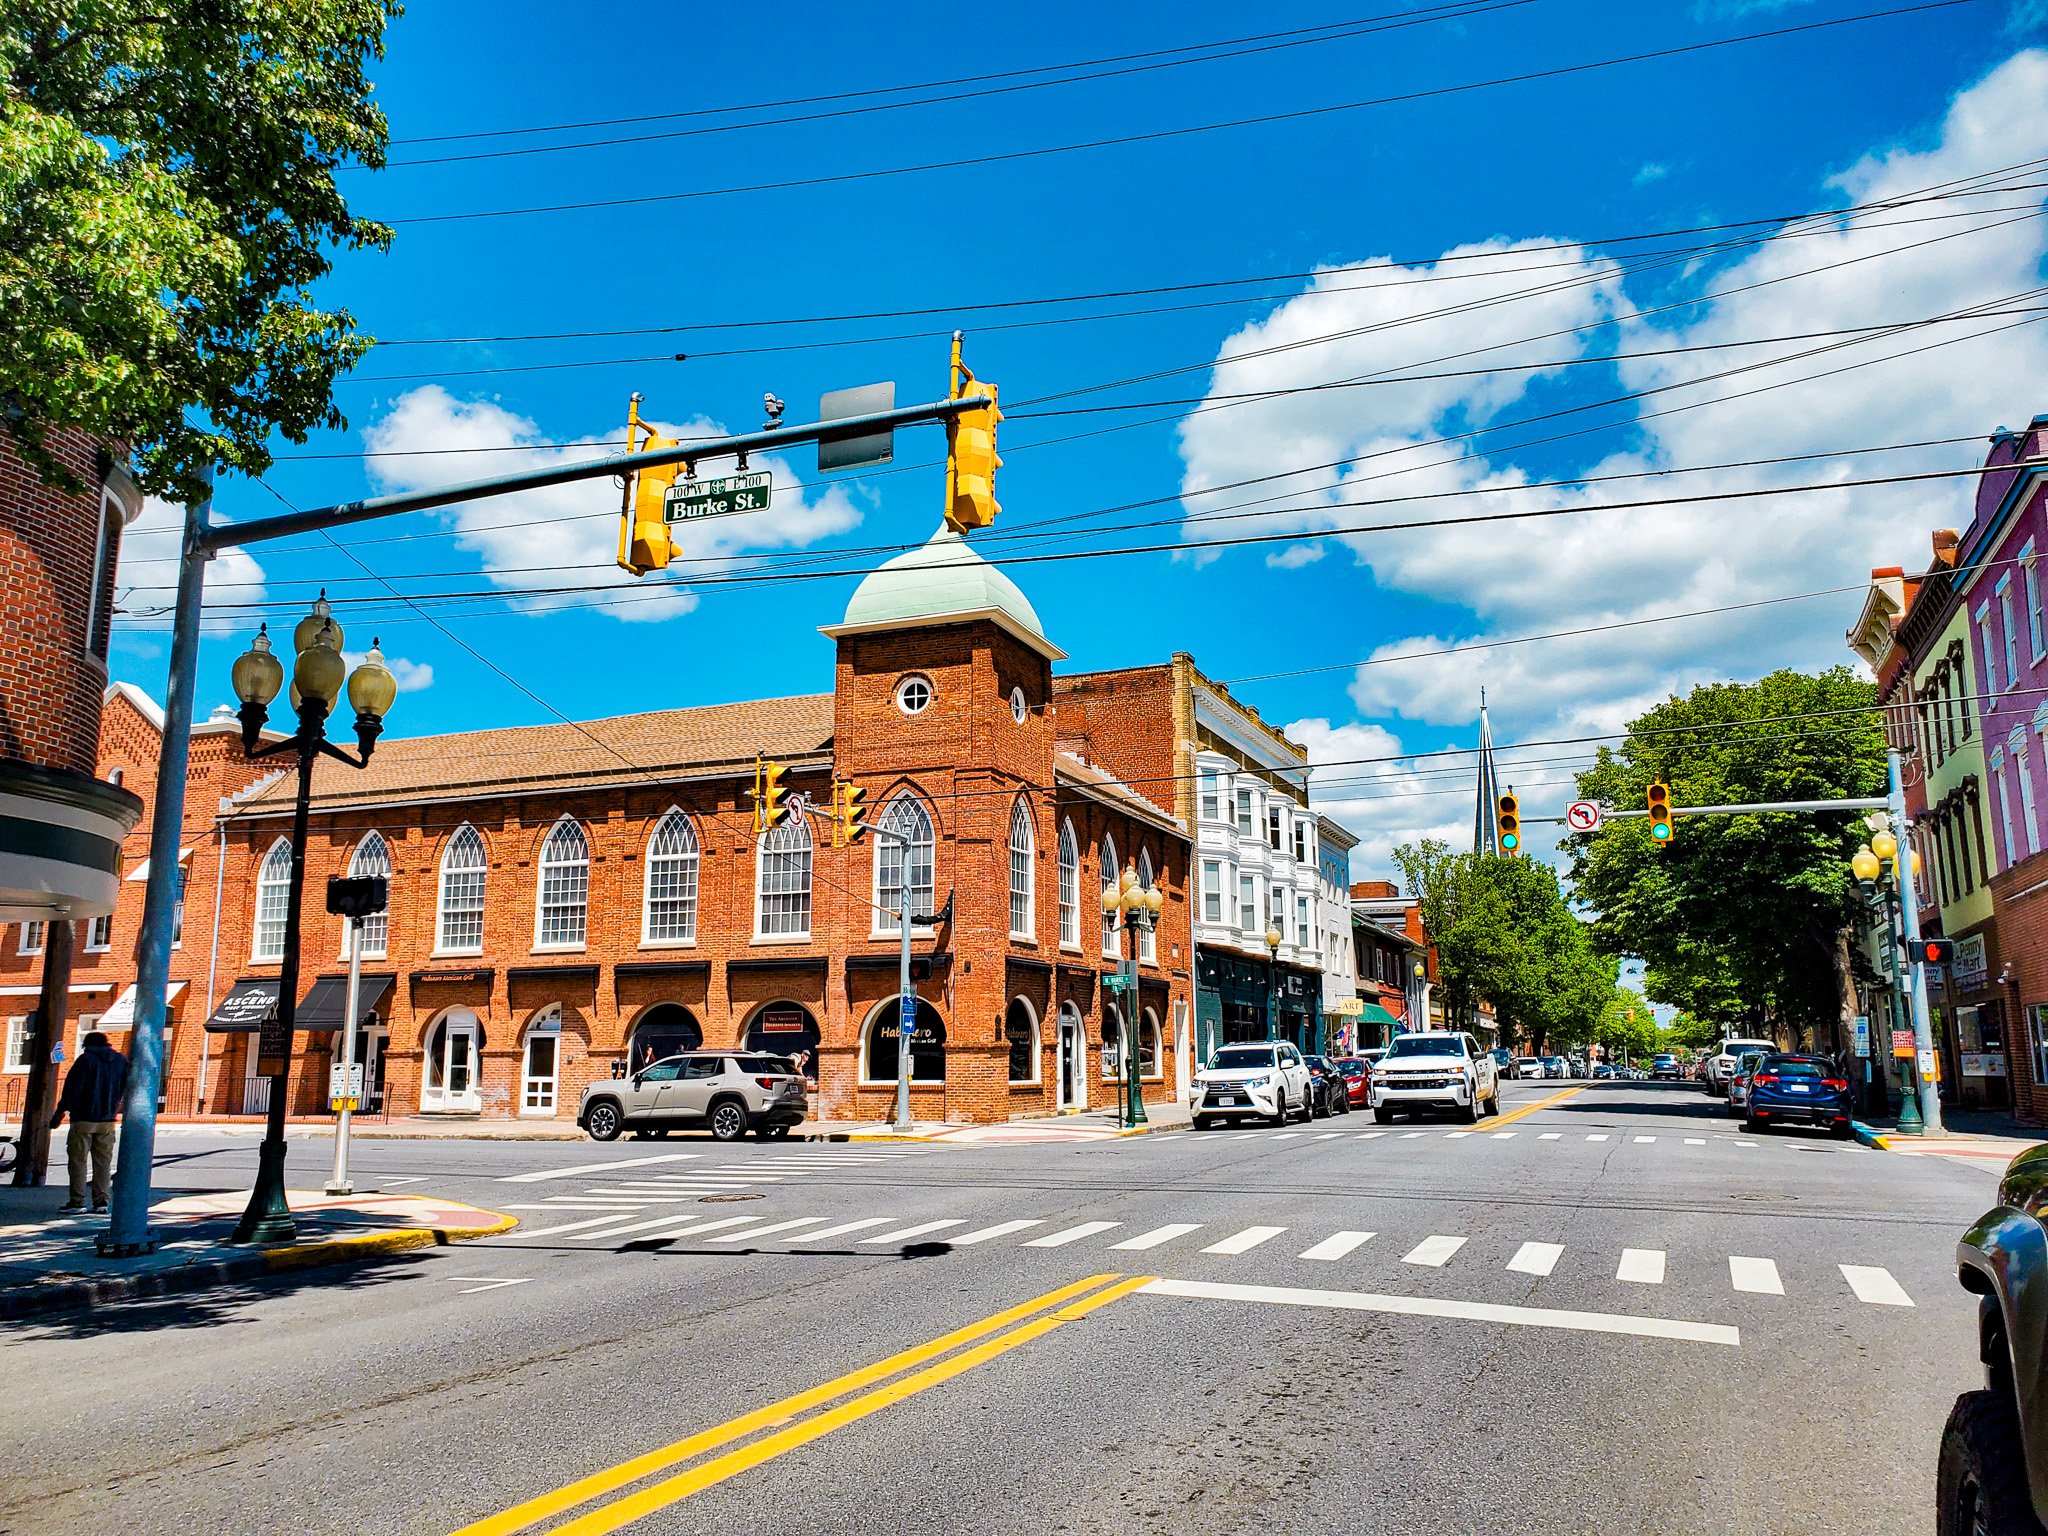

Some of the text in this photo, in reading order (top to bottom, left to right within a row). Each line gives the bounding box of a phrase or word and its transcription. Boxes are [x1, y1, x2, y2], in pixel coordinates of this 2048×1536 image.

[673, 475, 761, 499] 100 W E 100
[672, 493, 761, 520] Burke St.
[1960, 939, 1982, 958] Penny
[1963, 956, 1981, 974] Mart
[223, 996, 277, 1006] ASCEND
[1343, 1002, 1360, 1010] ART
[881, 1026, 932, 1038] Habero
